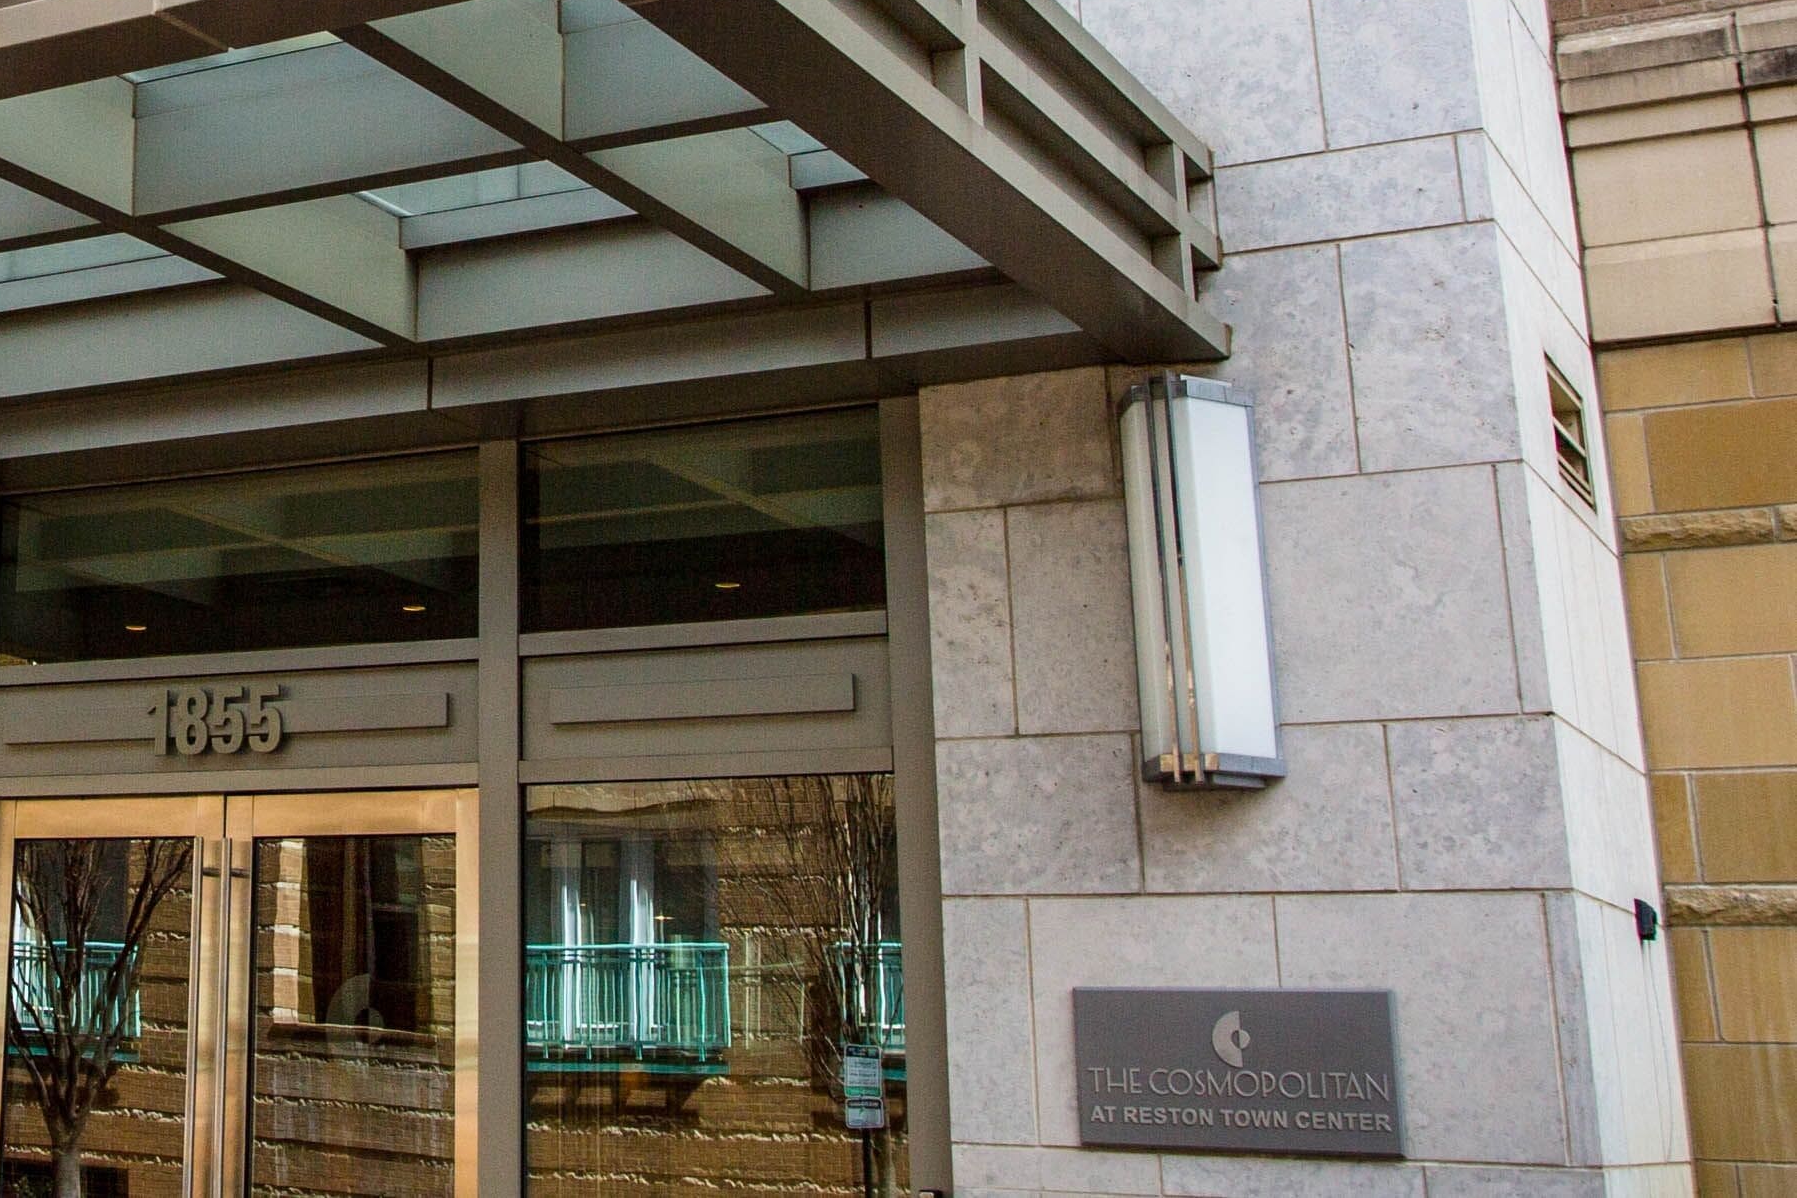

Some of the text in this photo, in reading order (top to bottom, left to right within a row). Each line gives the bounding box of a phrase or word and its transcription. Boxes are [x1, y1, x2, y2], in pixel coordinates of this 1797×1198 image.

[148, 683, 282, 756] 1855
[1088, 1067, 1391, 1102] THE COSMOPOLITAN
[1090, 1105, 1392, 1133] AT RESTON TOWN CENTER
